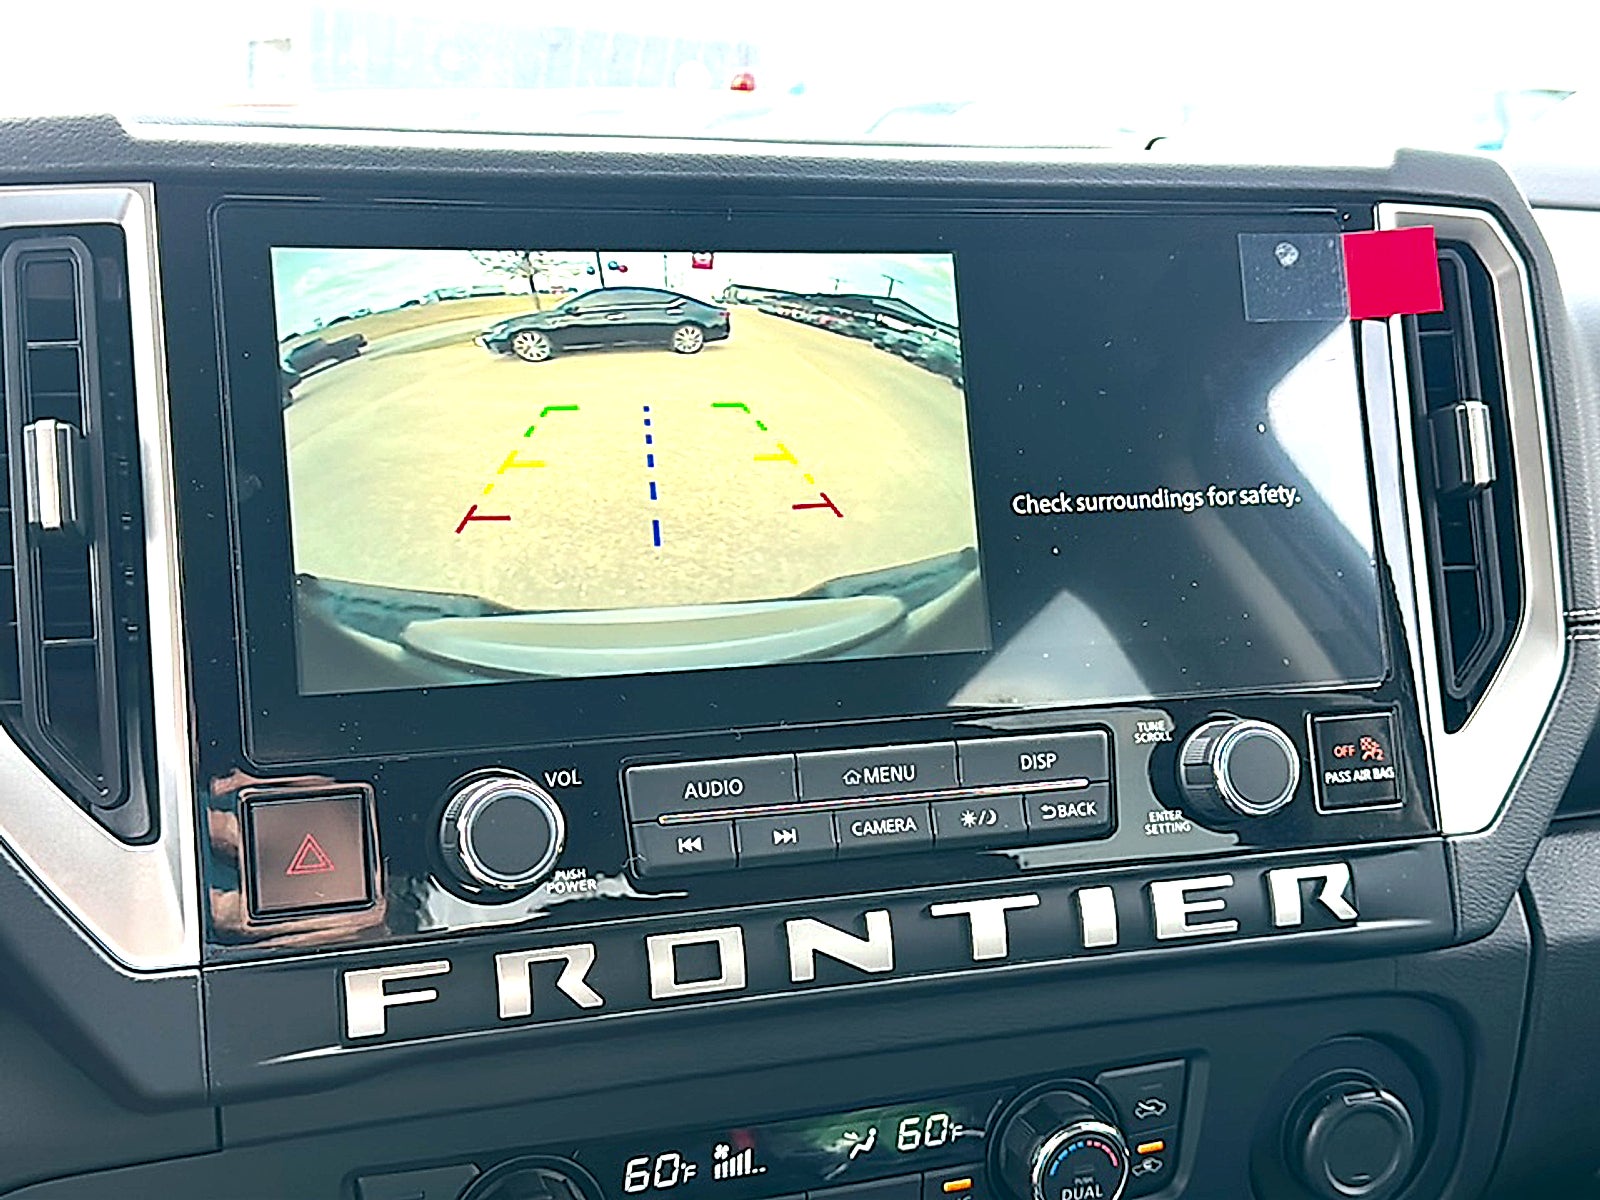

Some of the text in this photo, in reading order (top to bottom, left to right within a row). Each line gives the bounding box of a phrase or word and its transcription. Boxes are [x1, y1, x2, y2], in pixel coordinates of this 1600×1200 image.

[1011, 482, 1302, 515] Check surroundings for safety.
[1133, 731, 1173, 744] SCROLL
[1333, 744, 1356, 758] OFF
[1020, 752, 1058, 772] DISP
[544, 769, 583, 788] VOL
[863, 764, 917, 785] MENU
[1324, 770, 1352, 785] PASS
[1372, 766, 1395, 780] BAG
[683, 777, 745, 800] AUDIO
[1057, 801, 1098, 820] BACK
[1148, 809, 1183, 823] ENTER
[850, 816, 918, 838] CAMERA
[1144, 821, 1192, 836] SETTING
[554, 868, 587, 881] PUSH
[546, 878, 598, 895] POWER
[342, 862, 1358, 1040] FRONTIER
[1061, 1183, 1104, 1200] DUAL
